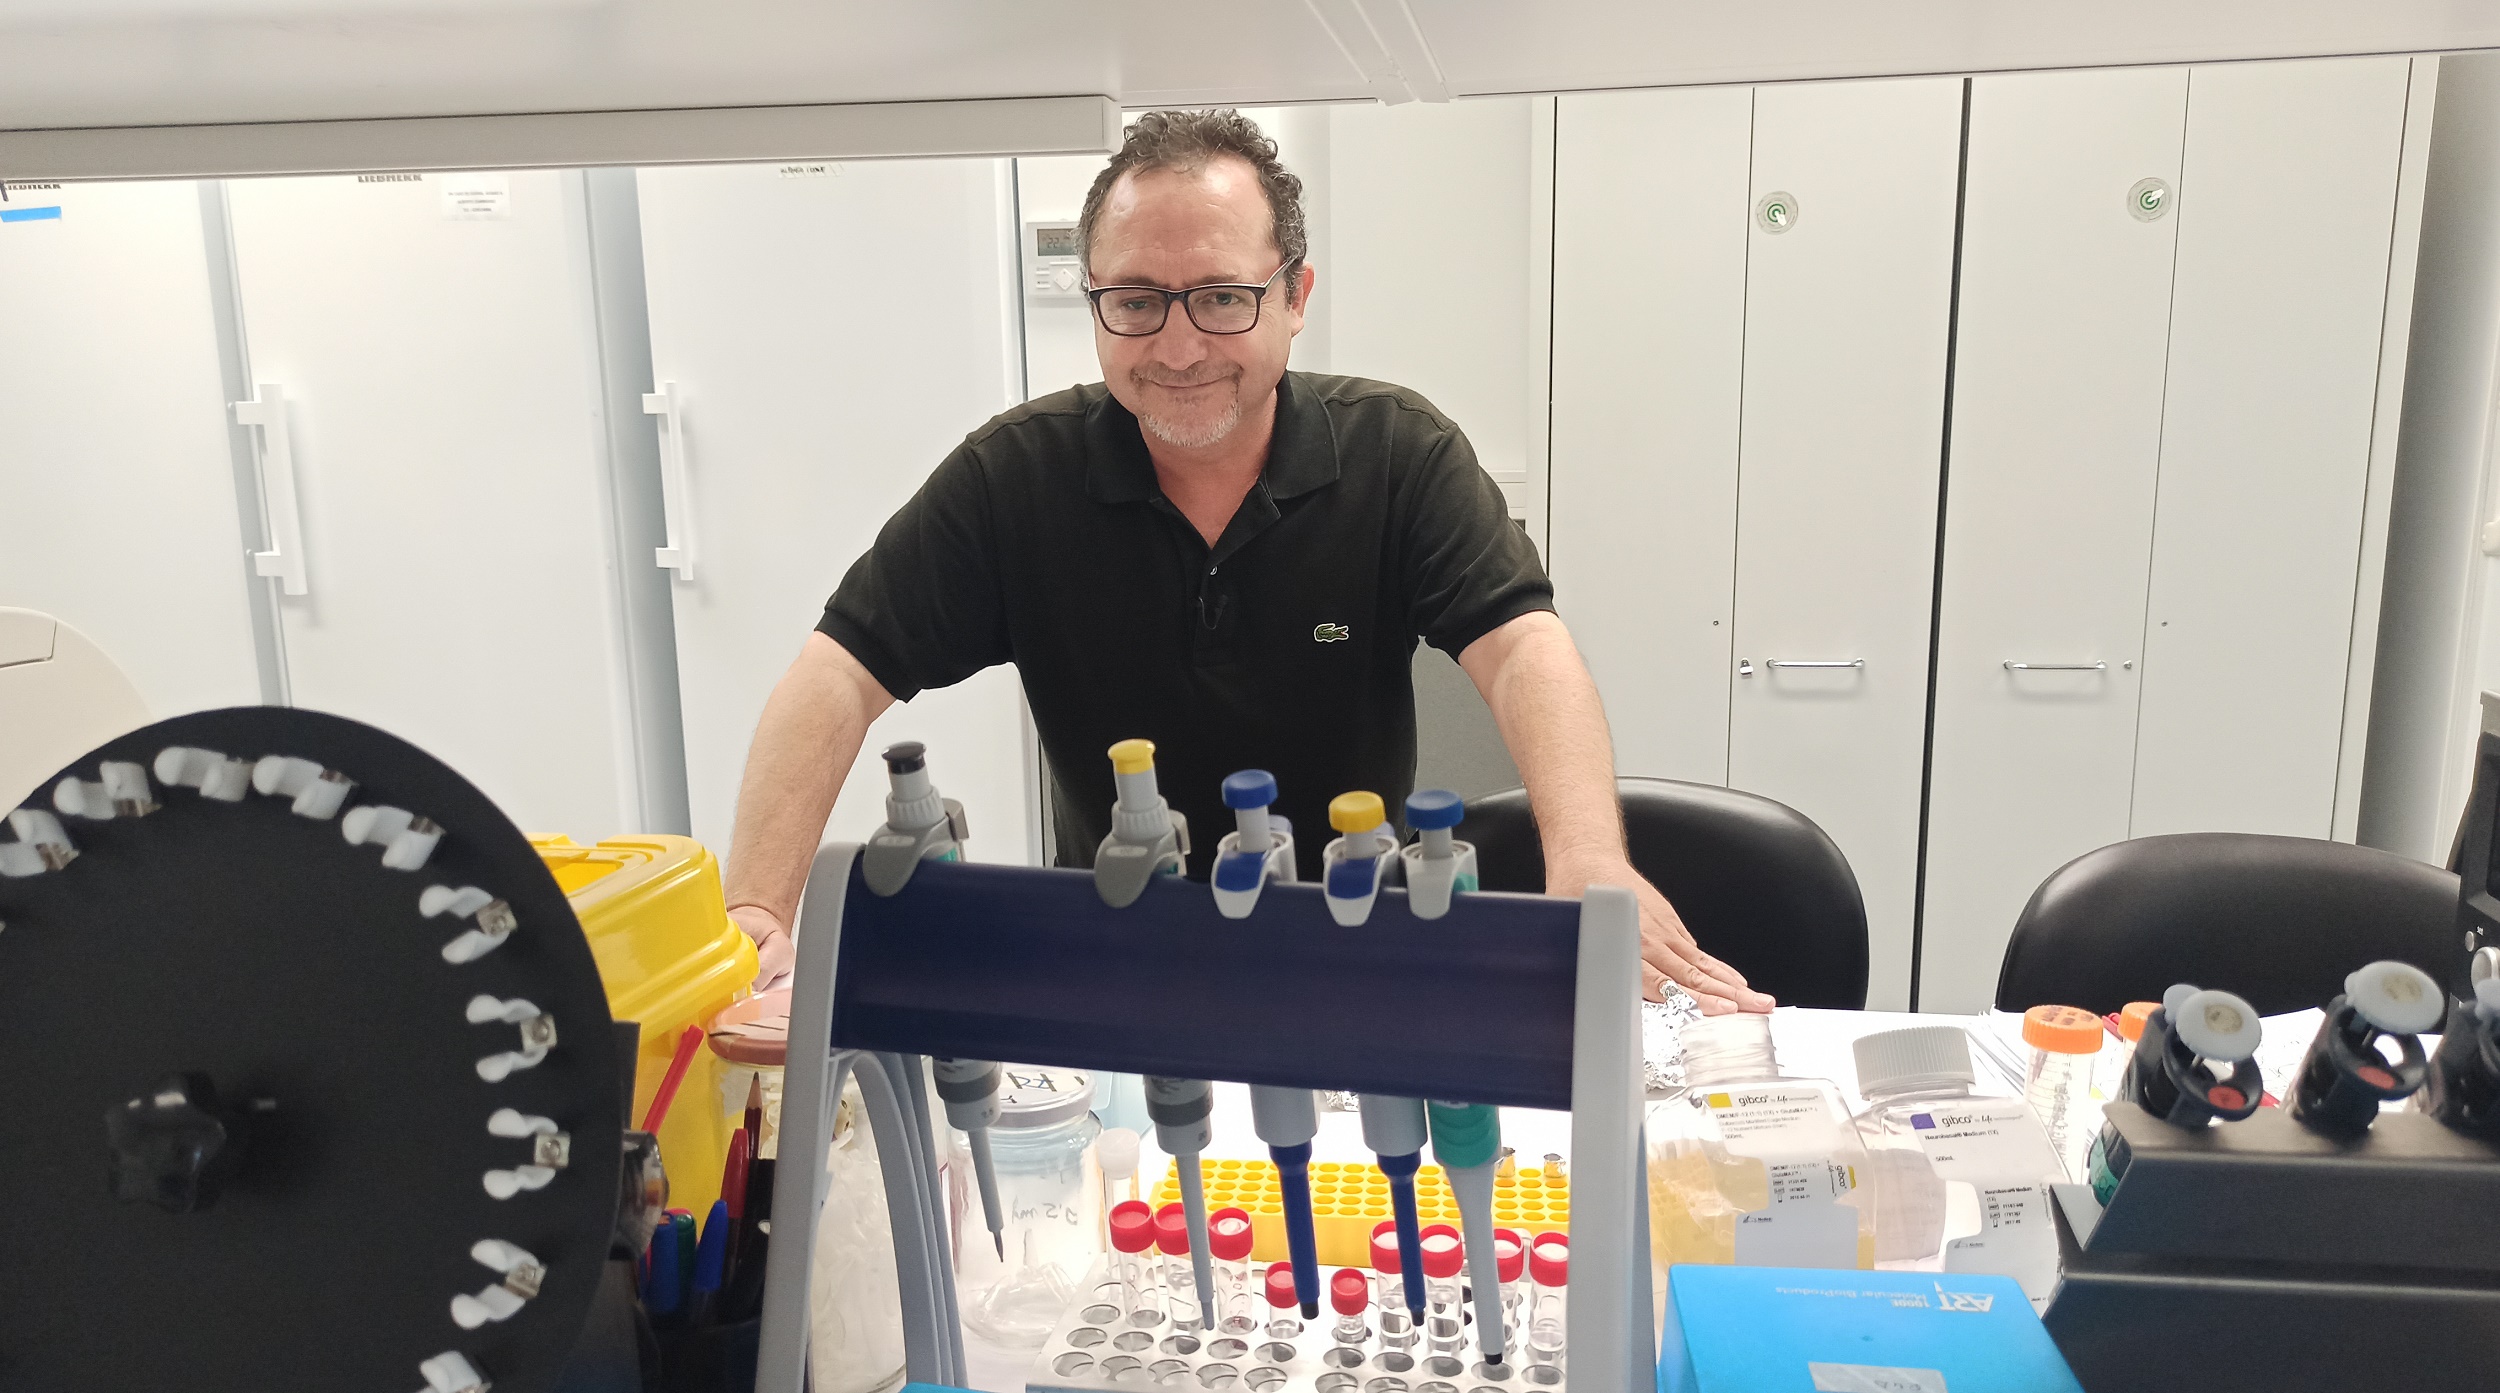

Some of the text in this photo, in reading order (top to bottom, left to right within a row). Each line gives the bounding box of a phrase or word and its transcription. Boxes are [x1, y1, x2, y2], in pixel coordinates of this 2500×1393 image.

[1775, 1286, 1927, 1301] Molecular BioProducts
[1934, 1280, 1995, 1313] ART
